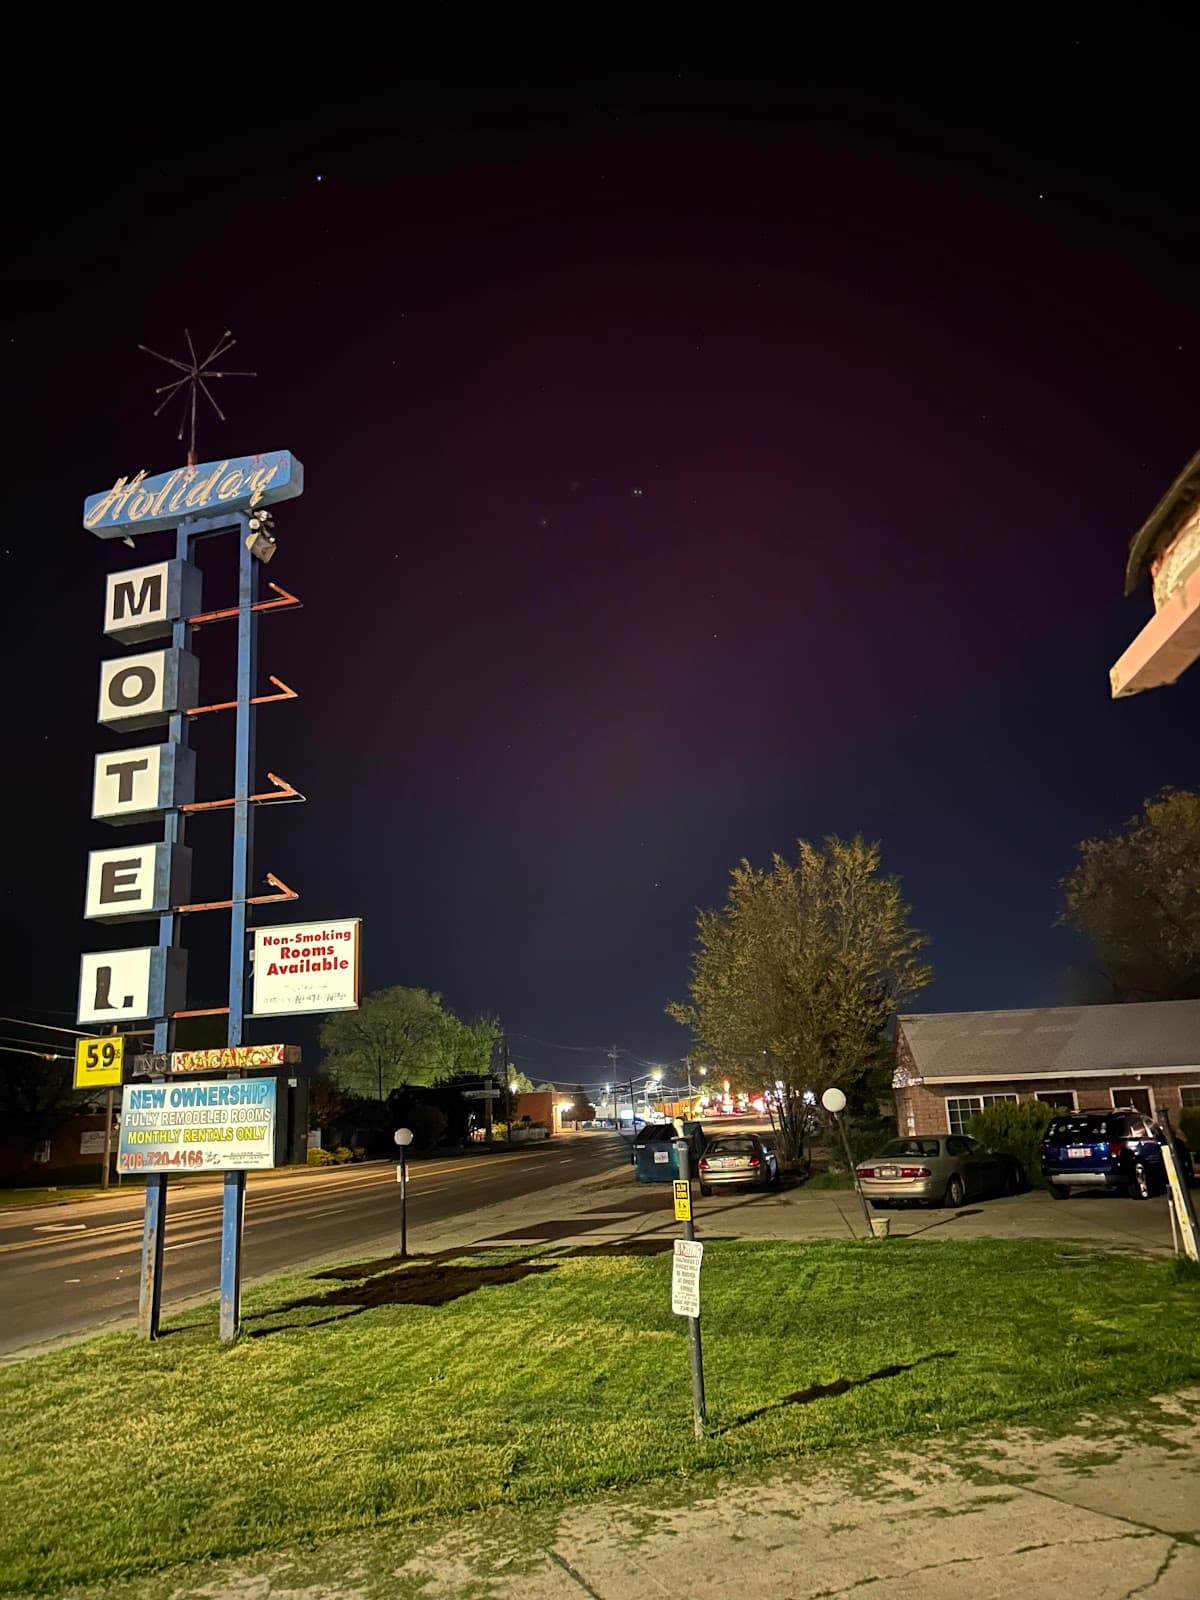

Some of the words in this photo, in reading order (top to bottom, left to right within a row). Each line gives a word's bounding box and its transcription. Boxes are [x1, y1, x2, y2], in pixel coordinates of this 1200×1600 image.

[84, 461, 279, 527] Holiday
[263, 930, 351, 947] Non-Smoking
[280, 945, 335, 960] Rooms
[267, 957, 349, 976] Available
[141, 1054, 168, 1073] NO
[173, 1045, 283, 1071] VACANCY
[130, 1089, 167, 1109] NEW
[170, 1084, 269, 1108] OWNERSHIP
[125, 1112, 160, 1127] FULLY
[161, 1110, 228, 1126] REMODELED
[231, 1108, 271, 1123] ROOMS
[128, 1129, 182, 1145] MONTHLY
[183, 1127, 234, 1143] RENTALS
[236, 1125, 268, 1140] ONLY
[121, 1150, 204, 1169] 208-720-4166
